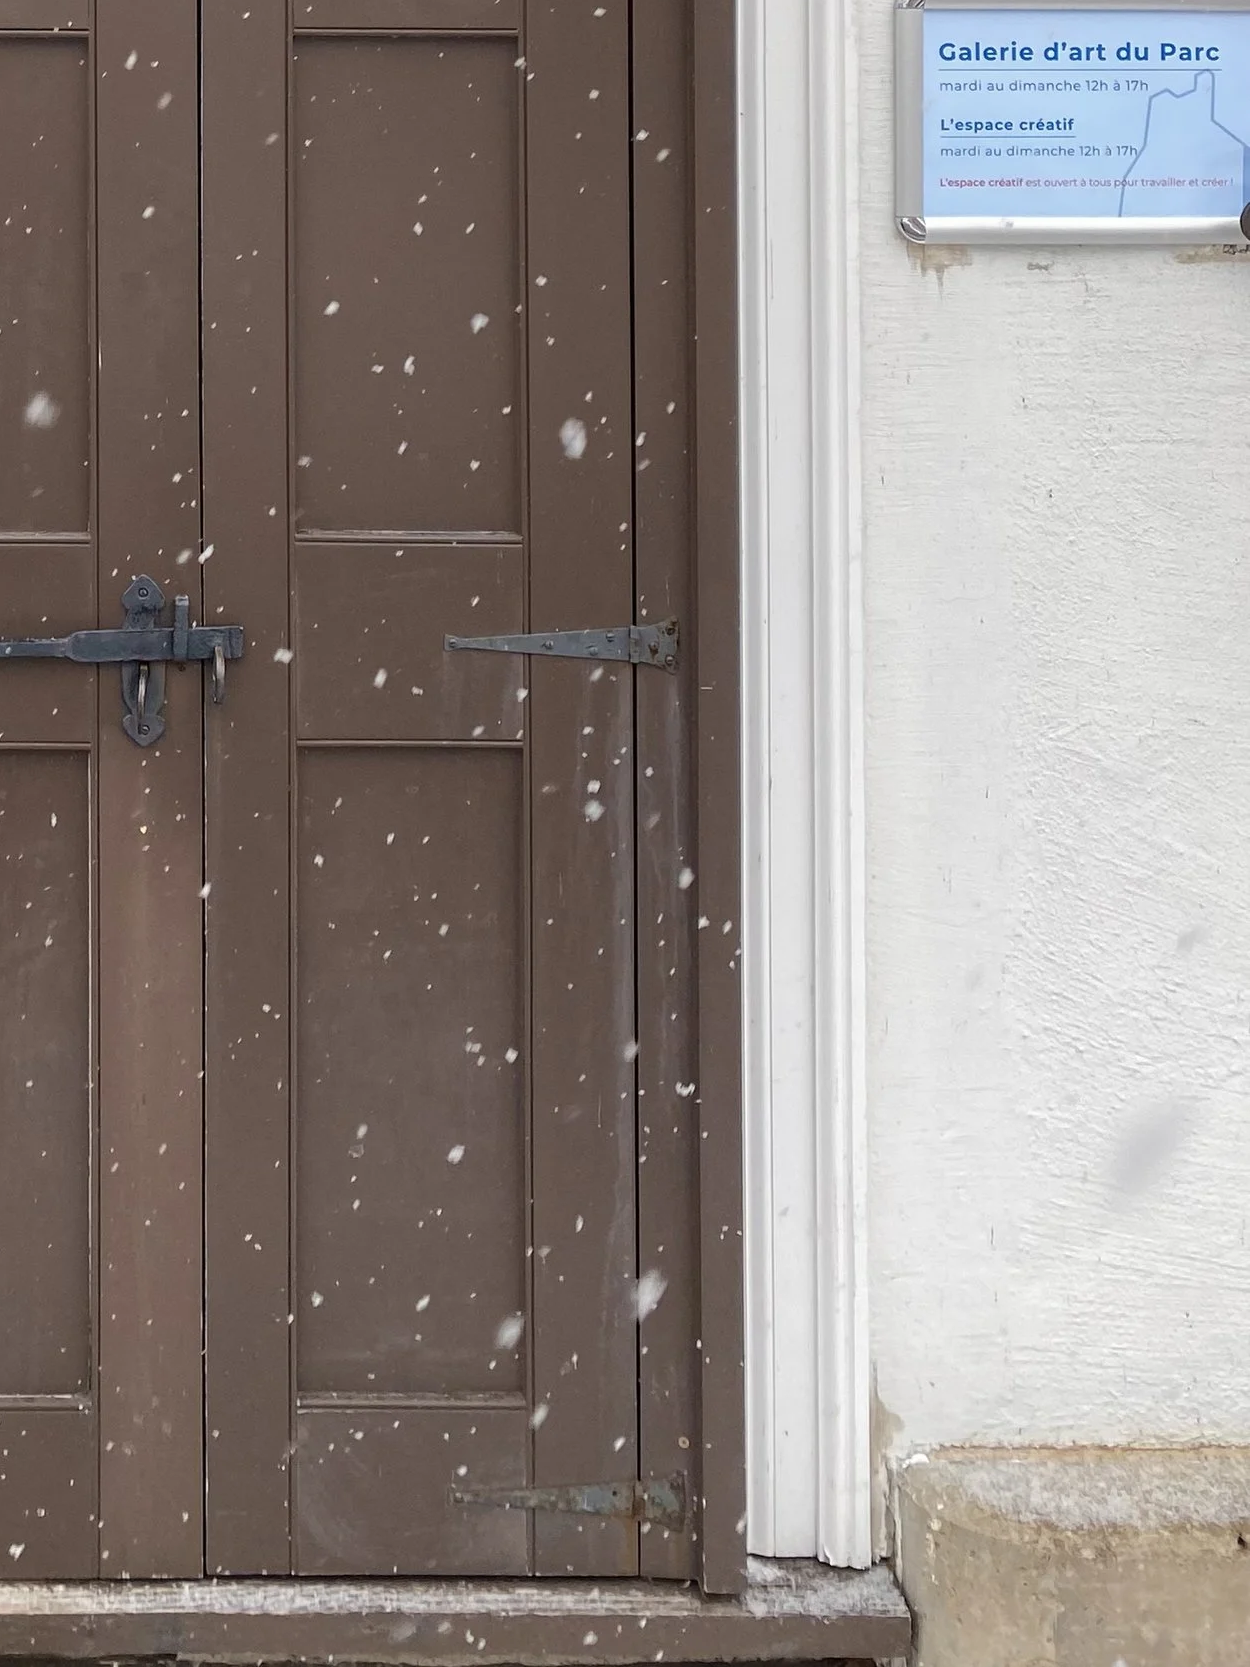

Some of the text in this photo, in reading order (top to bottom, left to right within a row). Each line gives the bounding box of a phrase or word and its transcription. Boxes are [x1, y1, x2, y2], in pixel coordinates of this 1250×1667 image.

[938, 41, 1220, 62] Galerie d’art du Parc
[939, 79, 1149, 92] mardi au dimanche 12h à 17h
[940, 117, 1075, 134] L’espace créatif
[940, 145, 1138, 157] mardi au dimanche 12h à 17h
[940, 178, 986, 189] L’espace
[988, 178, 1023, 188] créatif
[1025, 179, 1041, 188] est
[1044, 179, 1078, 188] ouvert
[1080, 178, 1087, 188] à
[1089, 179, 1112, 188] tous
[1114, 180, 1138, 190] pour
[1141, 178, 1186, 188] travailler
[1188, 179, 1199, 188] et
[1201, 178, 1228, 188] créer
